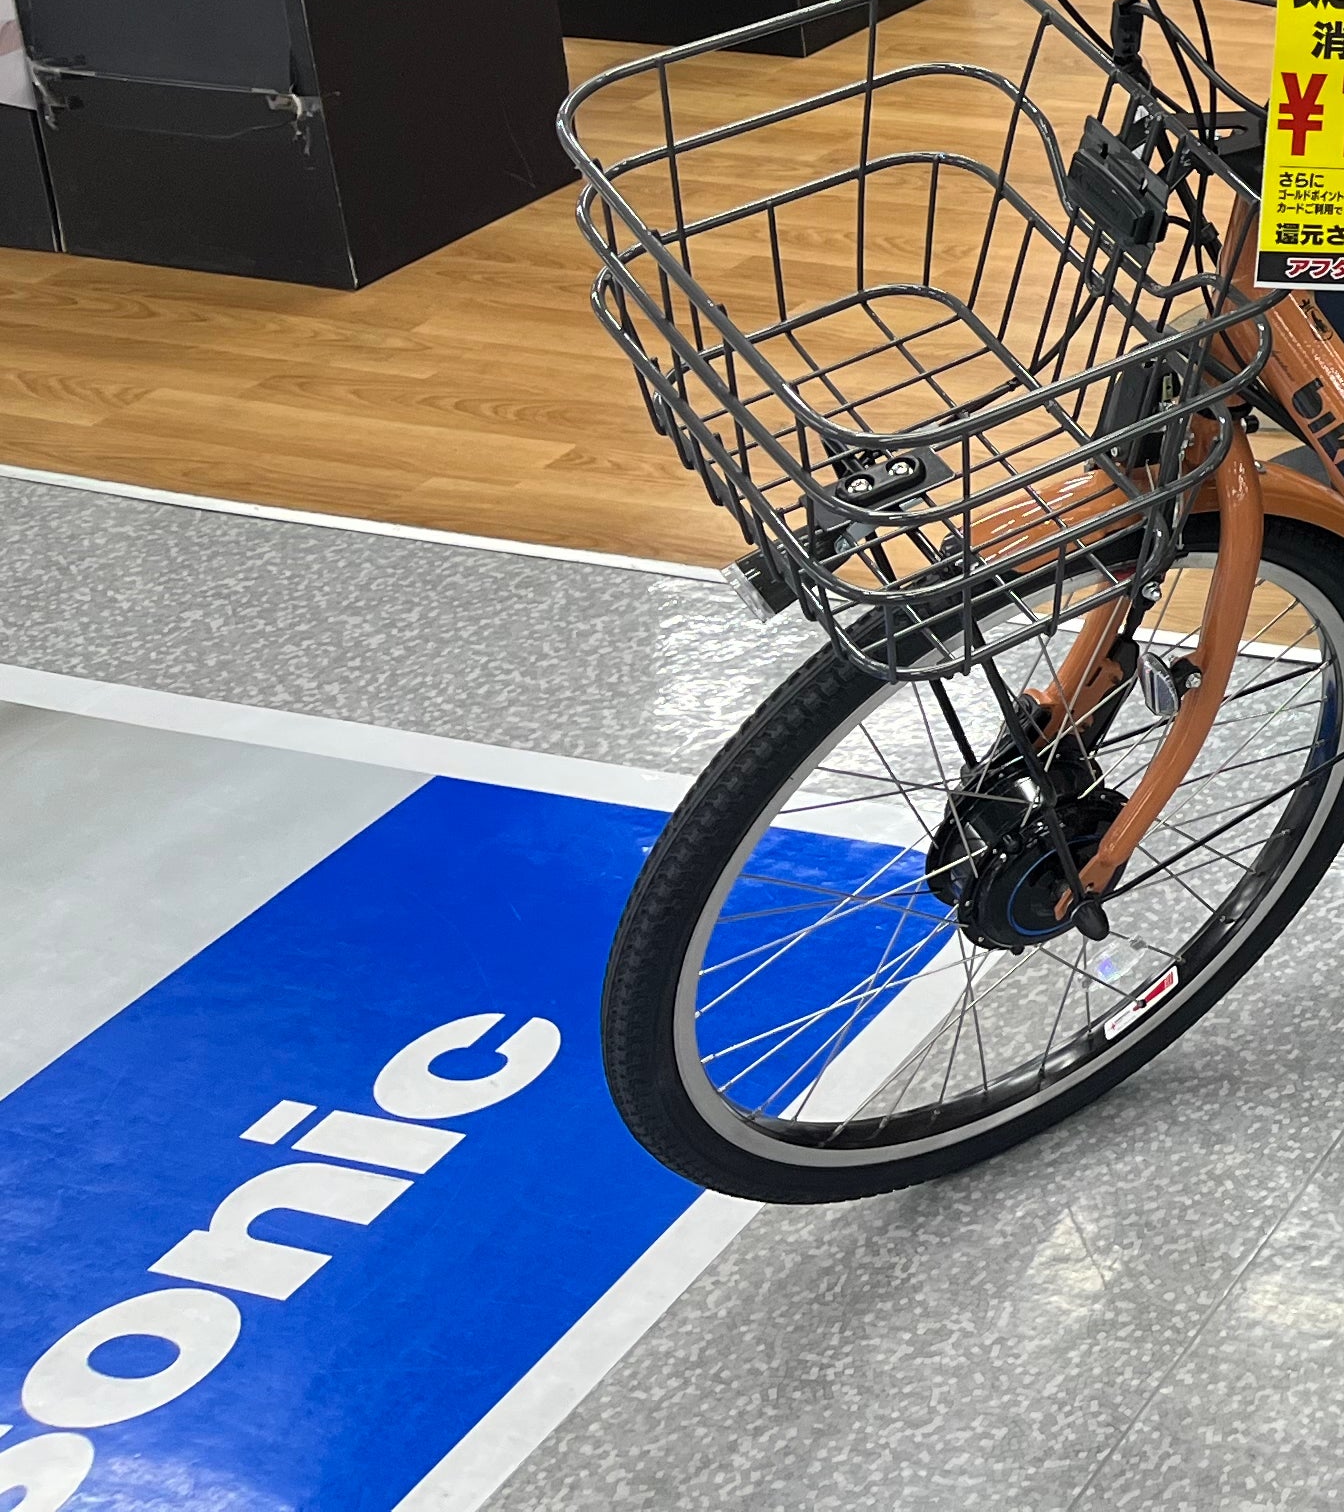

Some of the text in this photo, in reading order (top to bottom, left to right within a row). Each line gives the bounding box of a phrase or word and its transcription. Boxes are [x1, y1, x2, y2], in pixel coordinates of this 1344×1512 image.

[1278, 171, 1325, 189] さらに
[1277, 189, 1344, 202] ゴールドポイント
[1277, 201, 1344, 215] カードご利用で
